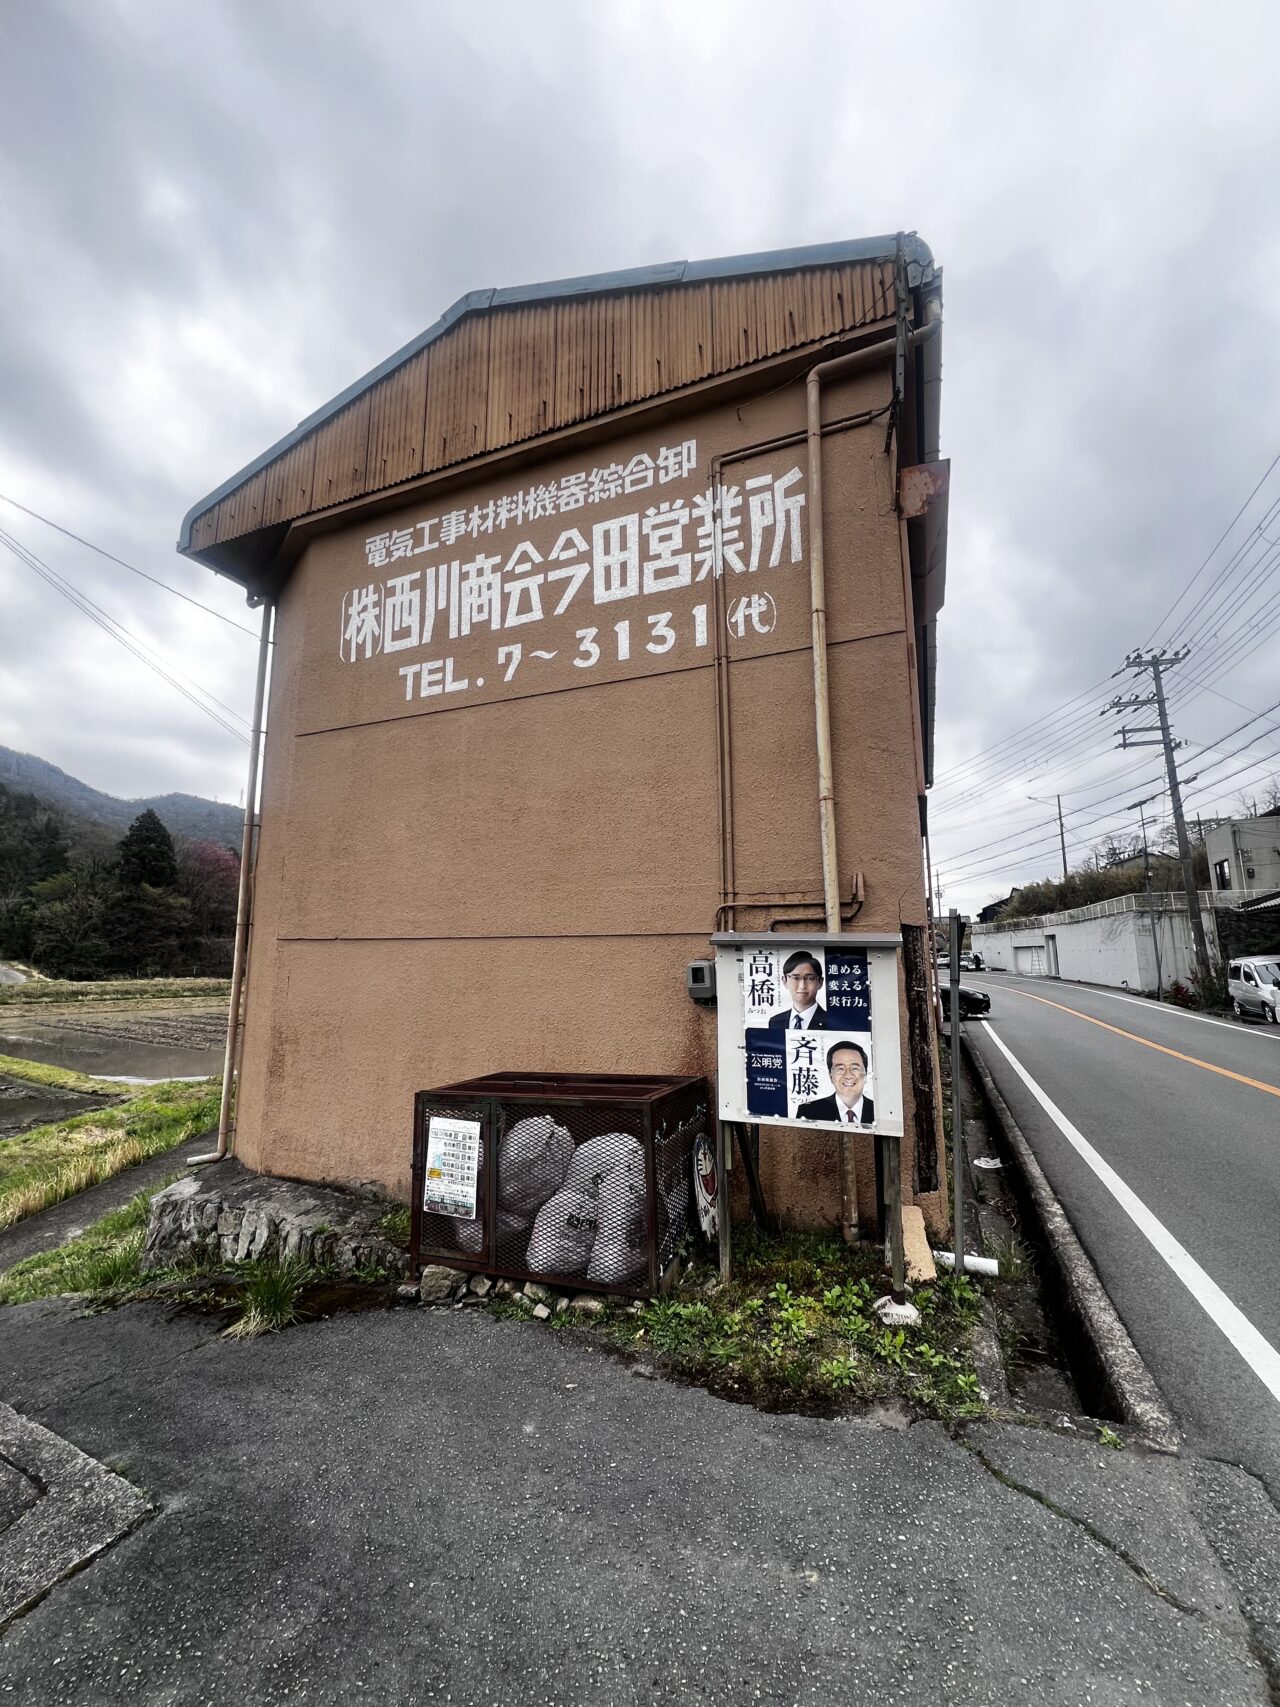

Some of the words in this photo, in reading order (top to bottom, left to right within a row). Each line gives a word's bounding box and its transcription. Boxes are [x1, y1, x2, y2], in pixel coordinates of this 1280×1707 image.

[828, 964, 861, 975] 進める
[747, 949, 775, 1007] 高橋
[828, 980, 862, 991] 変える
[828, 996, 868, 1007] 実行力。
[751, 1057, 783, 1069] 公明党
[790, 1036, 819, 1096] 斉藤
